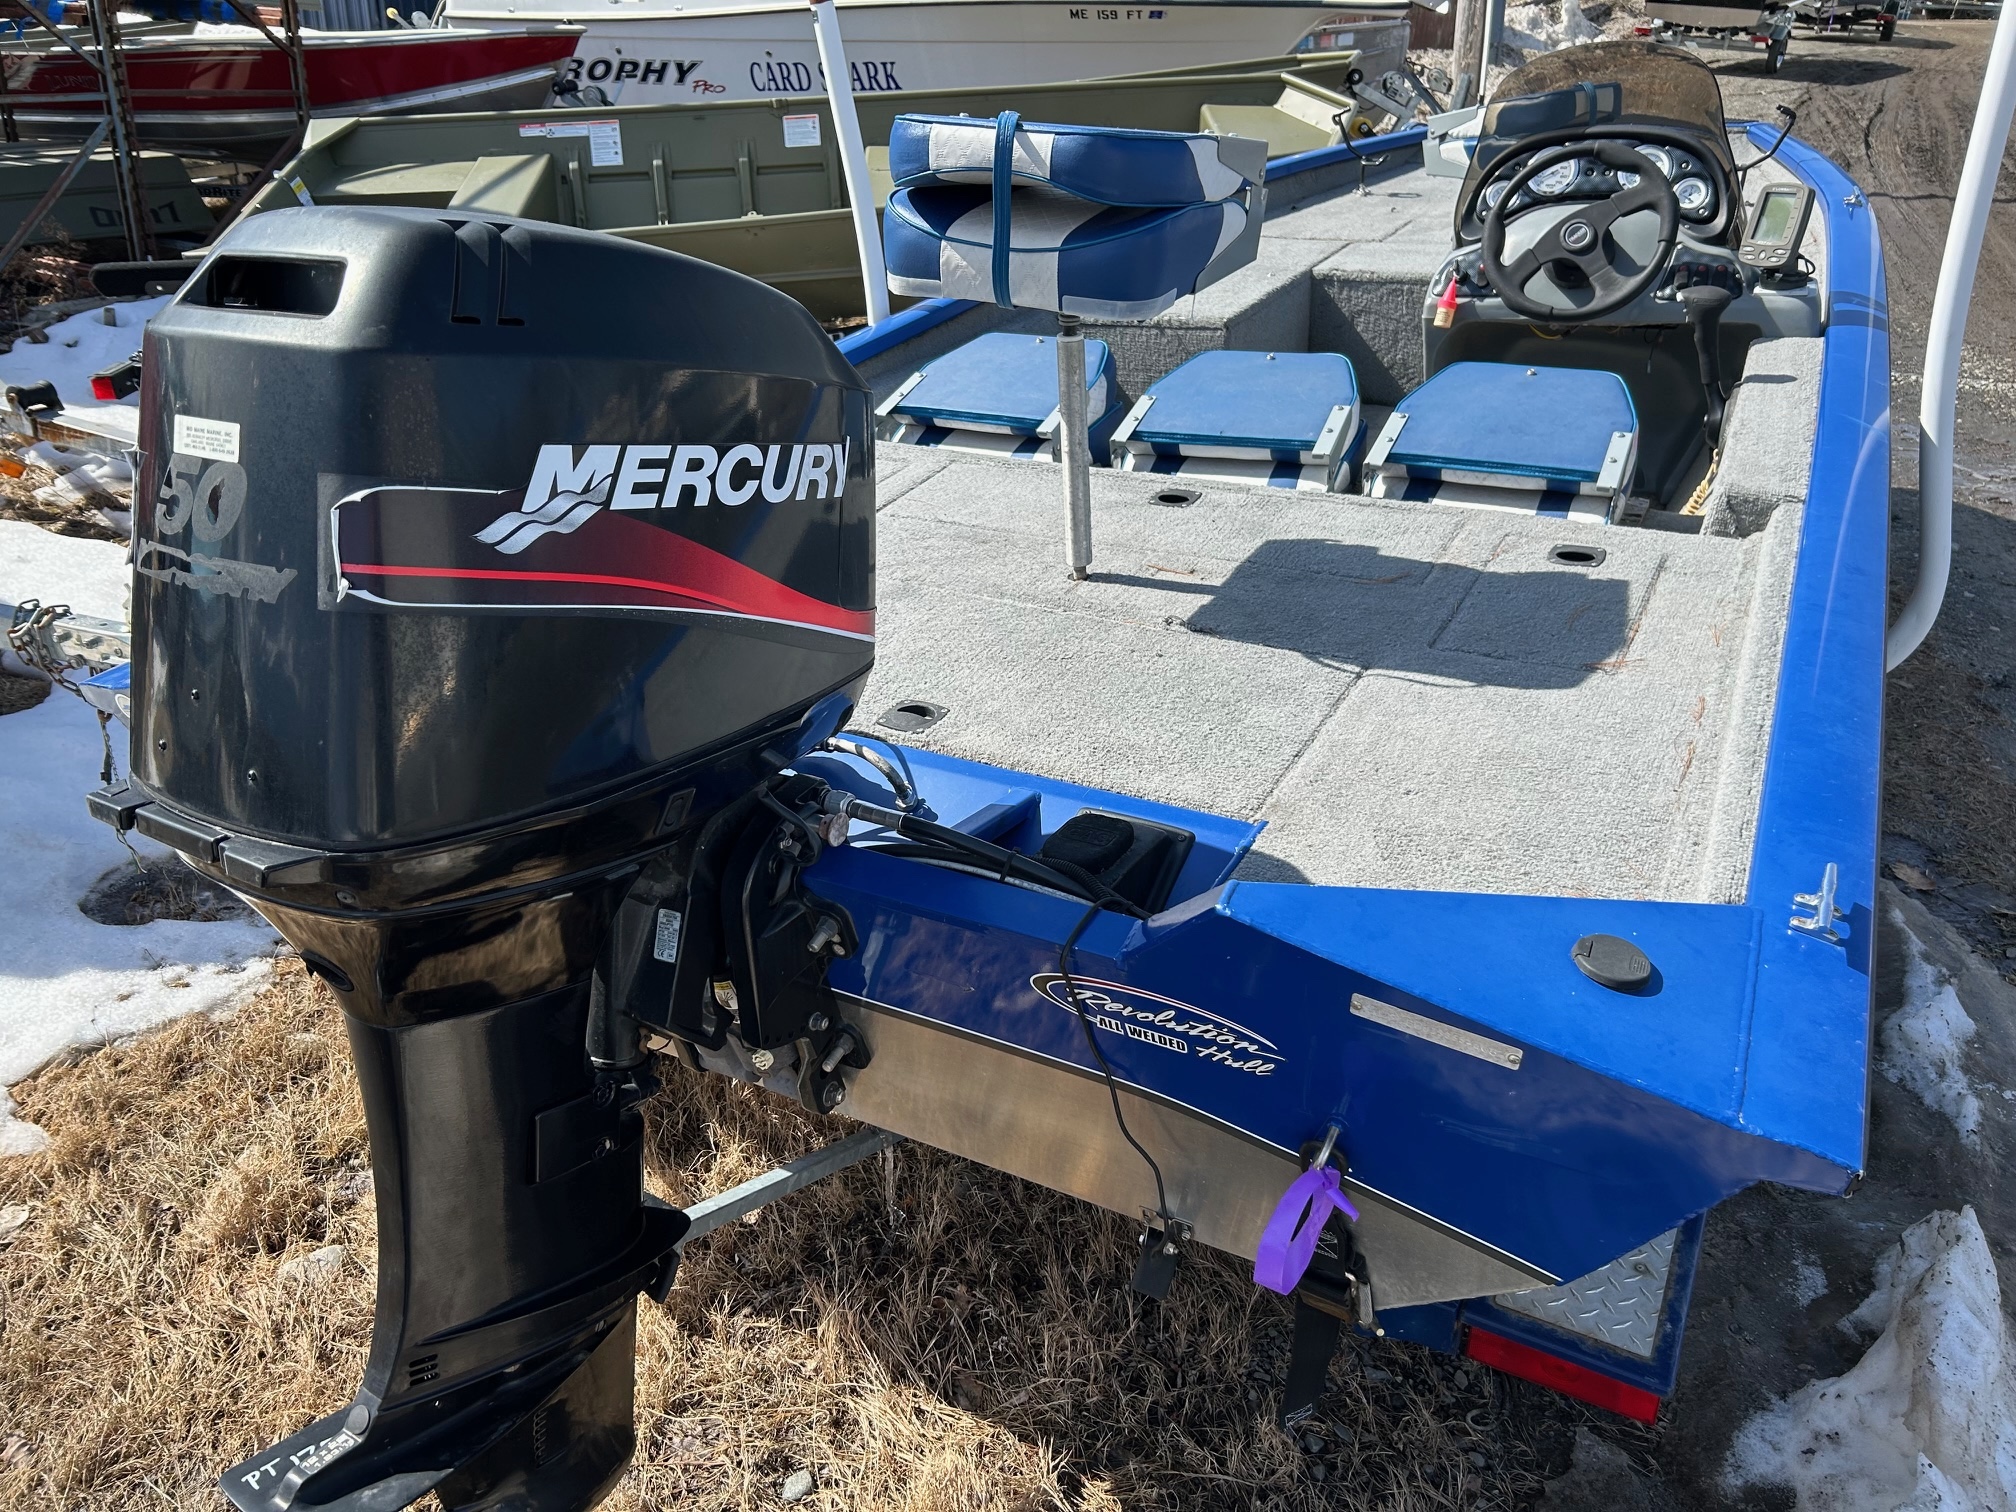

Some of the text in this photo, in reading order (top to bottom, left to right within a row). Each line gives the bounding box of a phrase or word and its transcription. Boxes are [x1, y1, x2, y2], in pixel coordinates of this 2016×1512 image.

[1069, 9, 1088, 19] ME
[1097, 9, 1118, 20] 159
[1127, 9, 1143, 19] FT
[566, 56, 703, 86] ROPHY
[749, 61, 903, 92] CARD ARK
[521, 436, 850, 512] MERCURY
[154, 453, 247, 542] 50
[1069, 828, 1110, 843] GAS
[1065, 986, 1287, 1062] Revolution
[1099, 1016, 1187, 1053] ALL WELDED
[1195, 1044, 1276, 1076] Hull
[241, 1437, 333, 1490] PT 17
